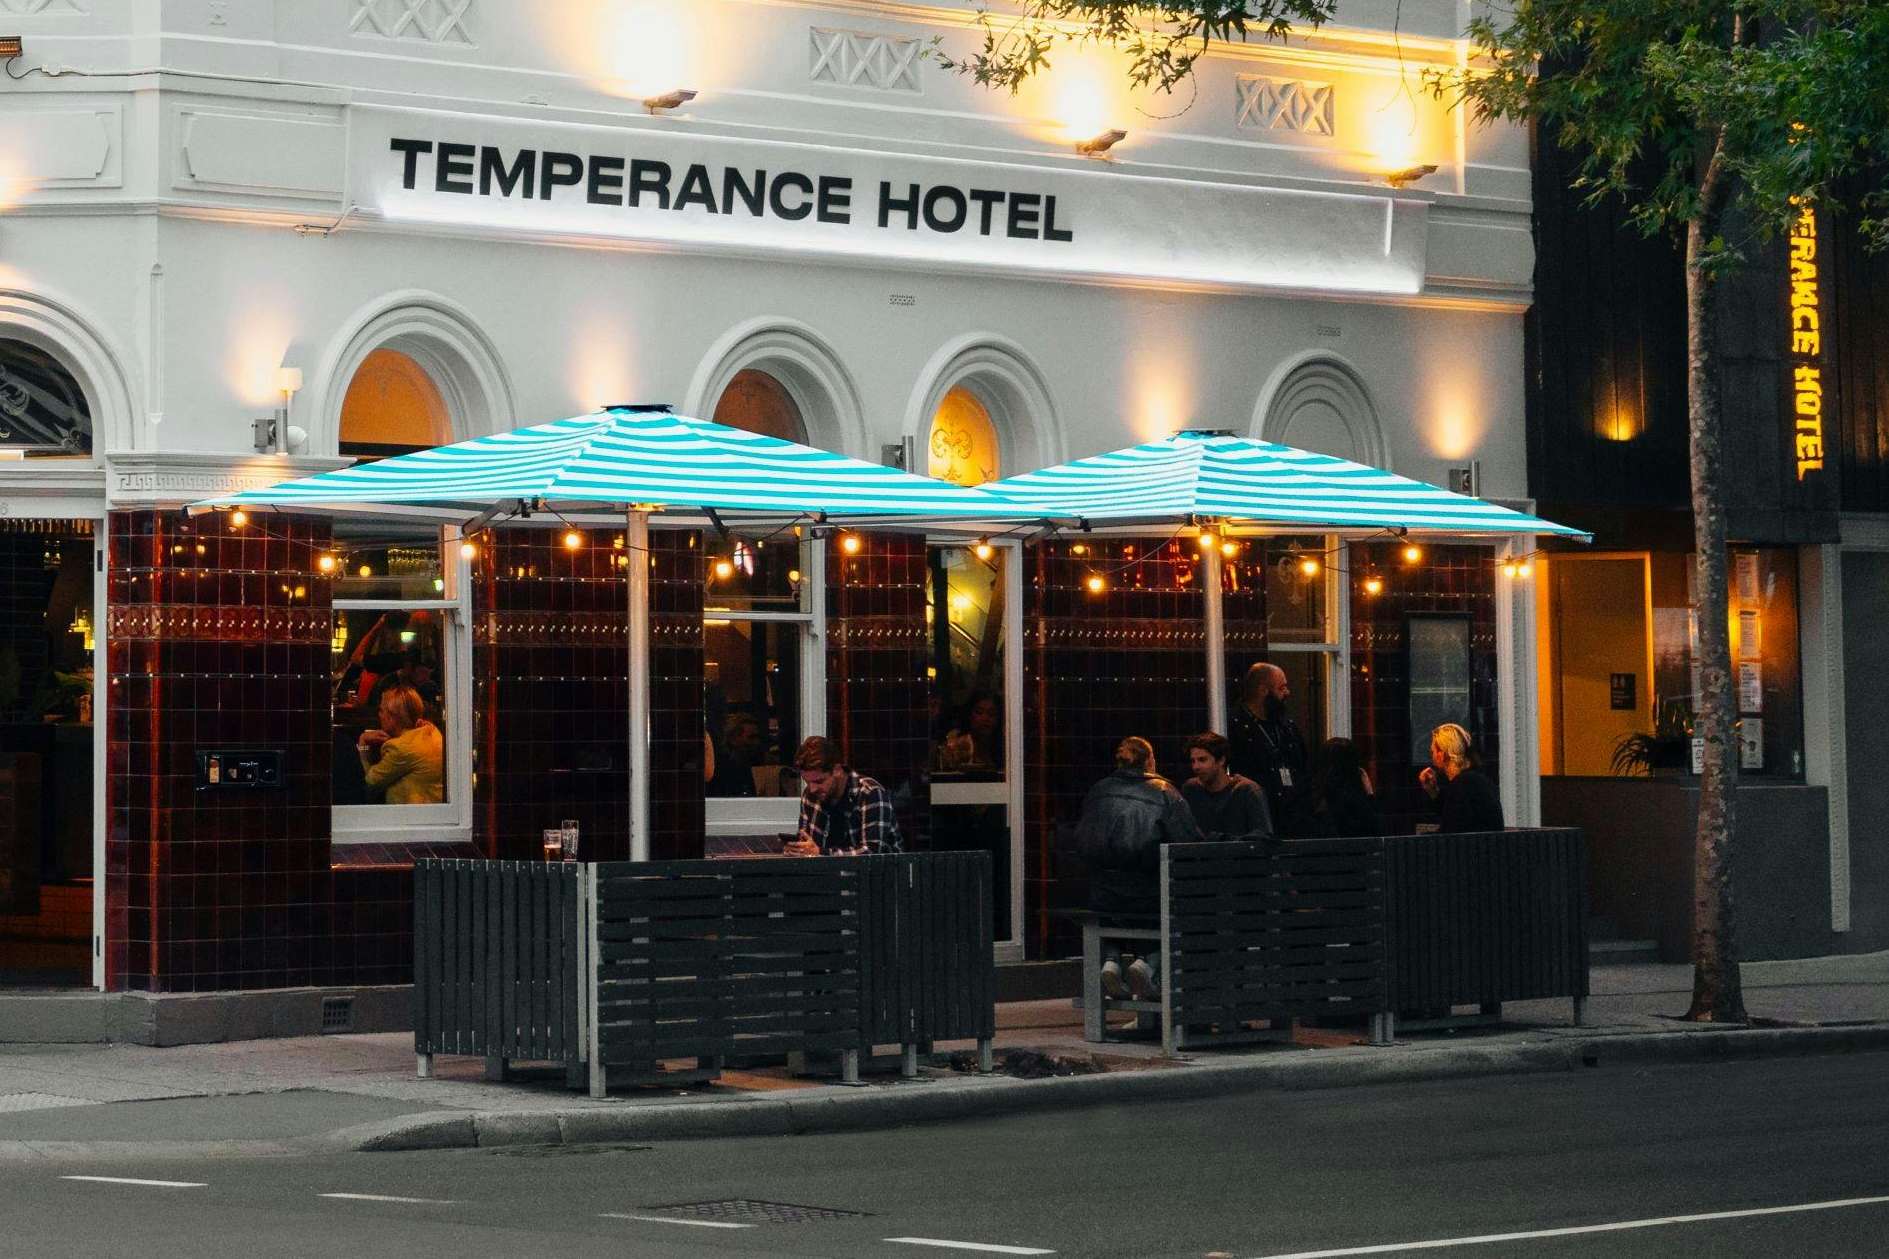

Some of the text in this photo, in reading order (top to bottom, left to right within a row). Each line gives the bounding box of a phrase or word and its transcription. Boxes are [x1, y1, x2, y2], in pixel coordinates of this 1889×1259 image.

[390, 137, 1073, 242] TEMPERANCE HOTEL
[1794, 366, 1823, 481] HOTEL
